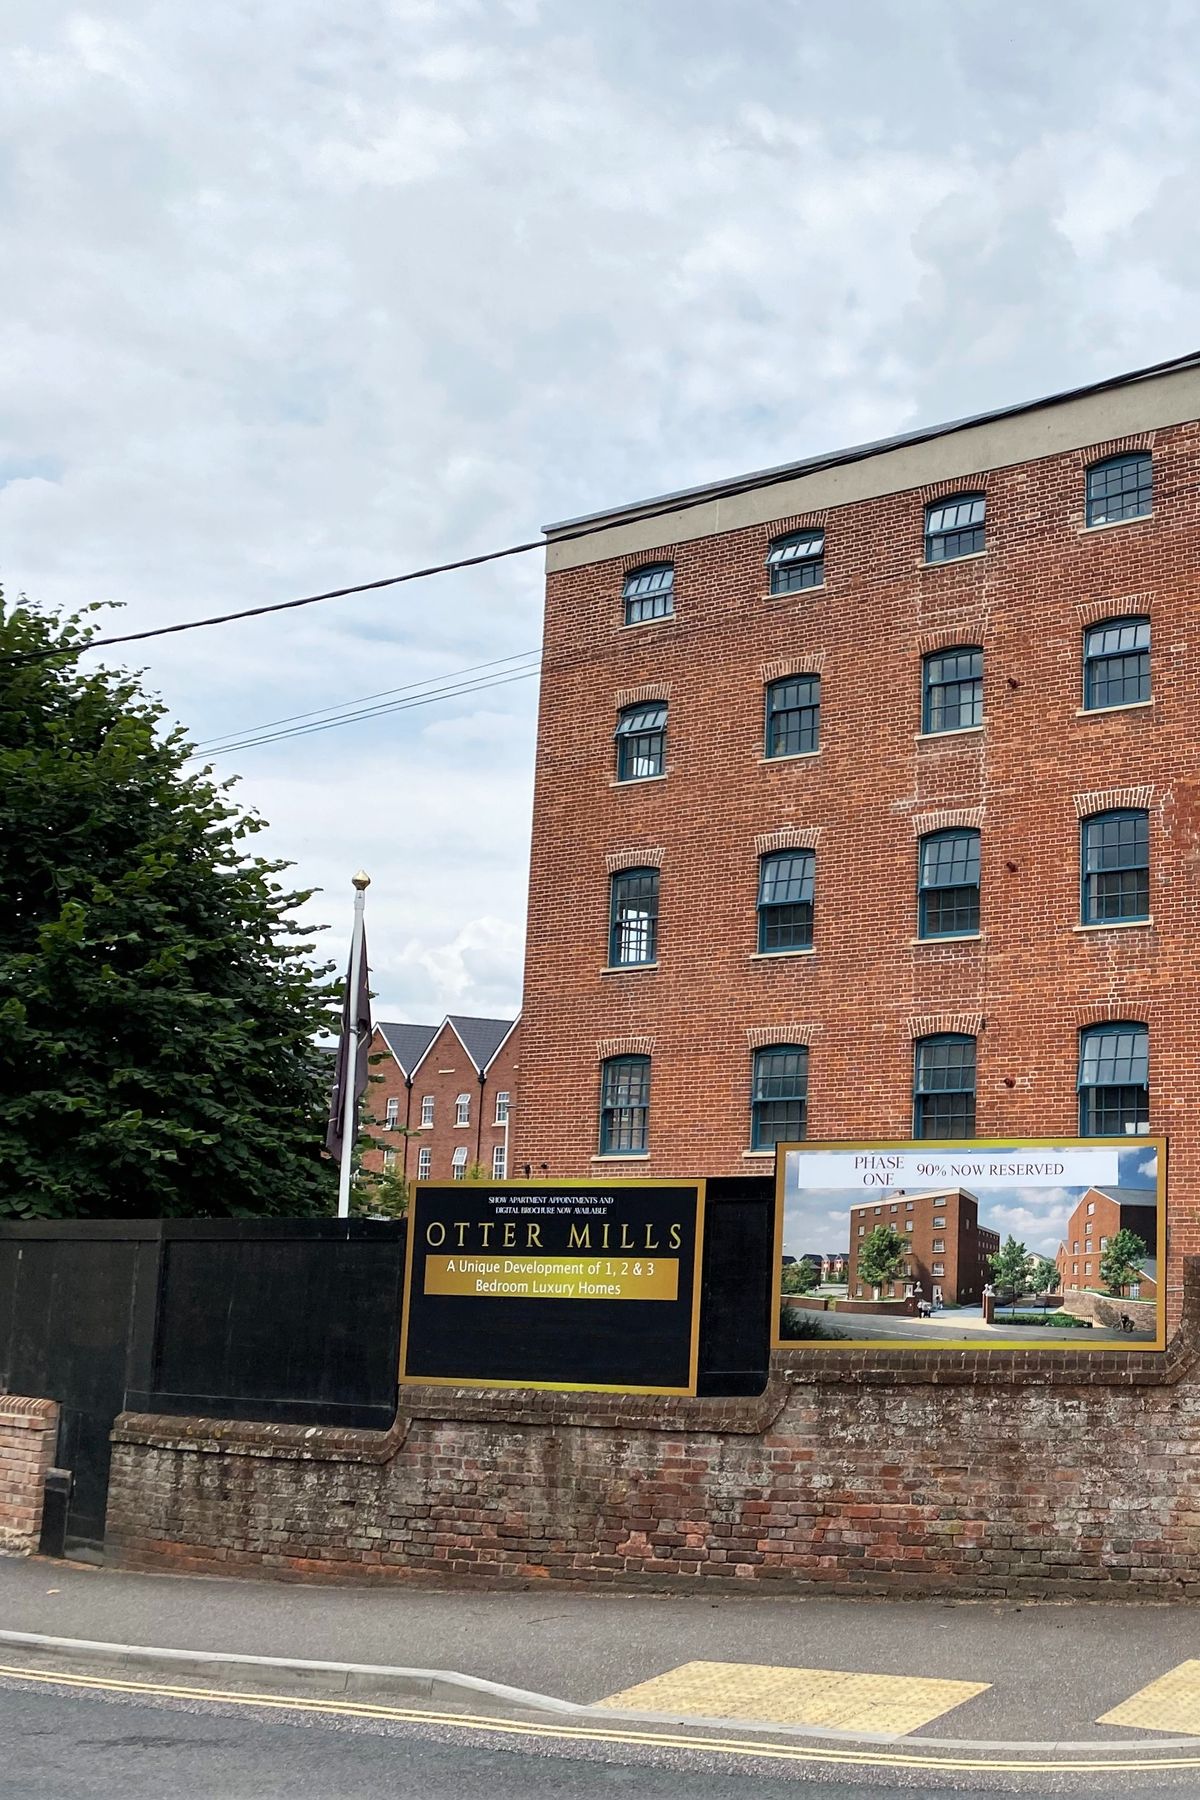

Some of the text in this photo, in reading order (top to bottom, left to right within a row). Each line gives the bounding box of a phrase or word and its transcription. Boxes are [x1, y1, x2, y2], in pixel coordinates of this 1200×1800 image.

[854, 1156, 905, 1170] PHASE
[916, 1163, 1065, 1177] 90% NOW RESERVED
[862, 1172, 895, 1186] ONE
[488, 1196, 614, 1204] SHOW APARTMENT APPOINTMENTS AND
[495, 1206, 607, 1215] DIGITAL BROCHURE NOW AVAILABLE
[426, 1222, 682, 1250] OTTER MILLS
[446, 1260, 654, 1277] A Unique Development of 1, 2 & 3
[476, 1279, 621, 1297] Bedroom Luxury Homes
